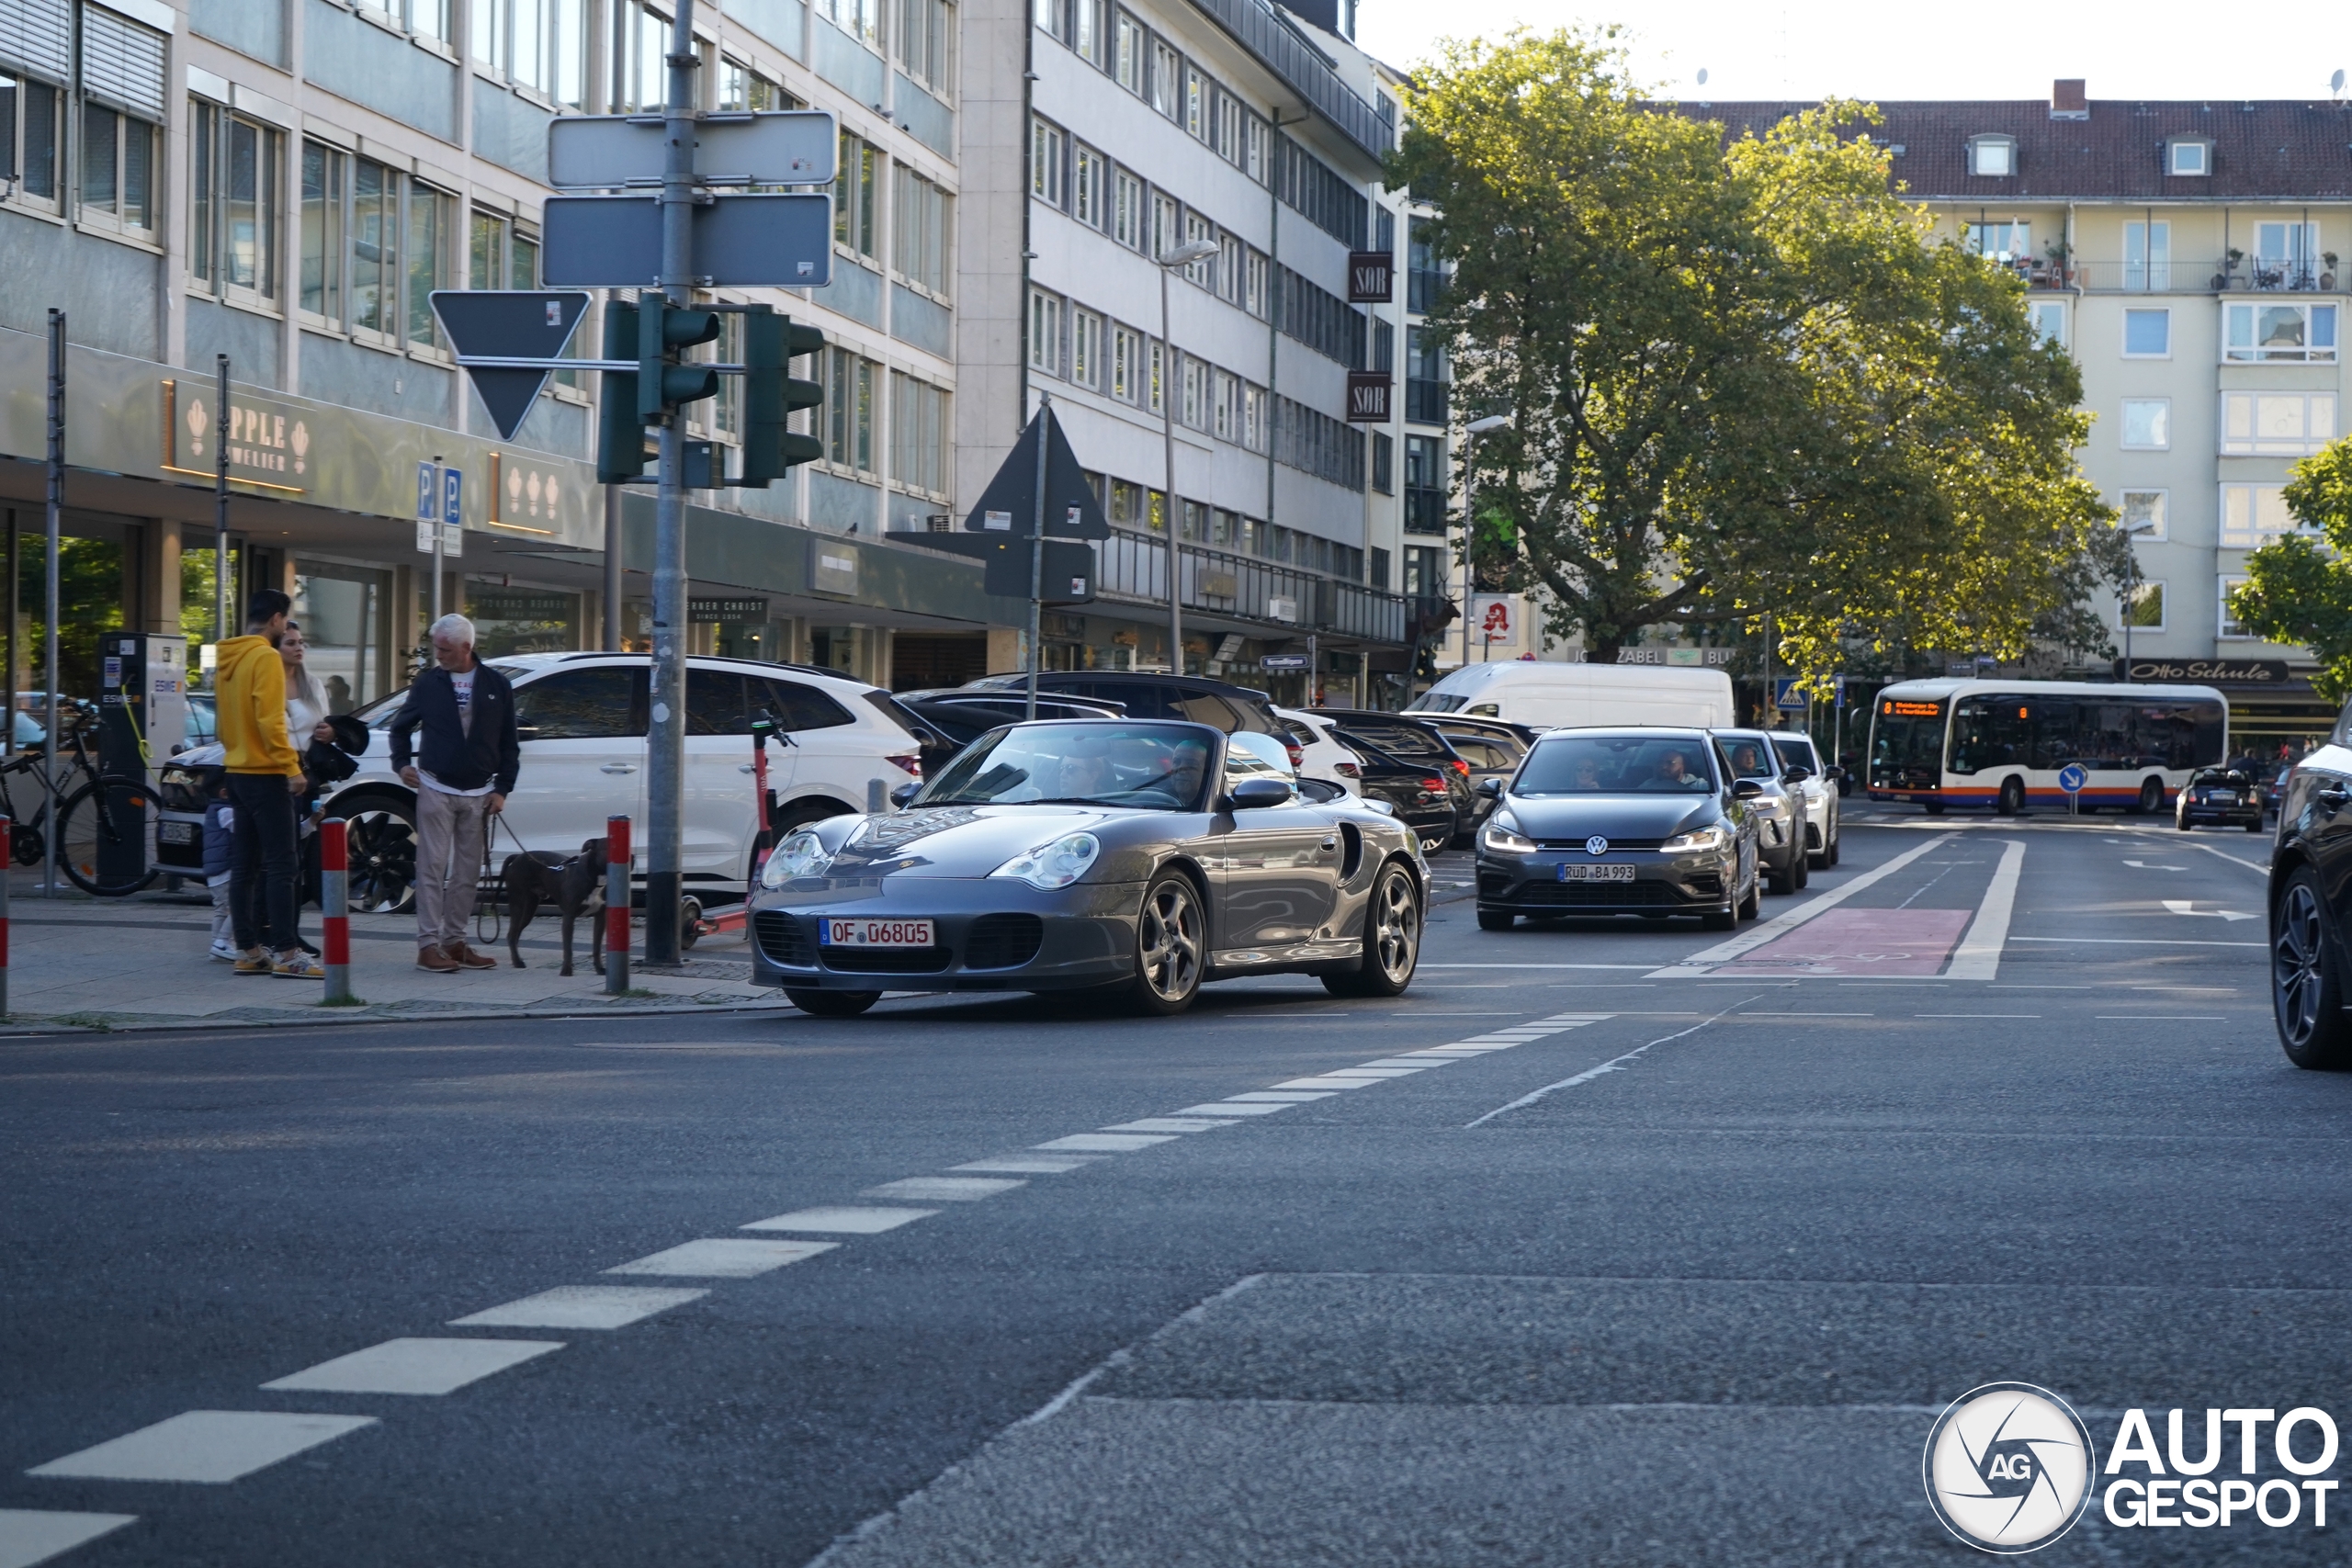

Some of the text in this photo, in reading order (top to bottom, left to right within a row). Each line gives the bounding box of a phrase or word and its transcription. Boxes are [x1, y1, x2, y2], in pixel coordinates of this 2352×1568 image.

[216, 402, 286, 449] PPLE
[421, 469, 431, 511] P
[447, 476, 458, 516] P
[724, 602, 763, 611] CHRIST
[1616, 650, 1661, 665] ZABEL
[2131, 663, 2185, 680] Otto
[1883, 701, 1892, 715] 8
[1595, 866, 1610, 878] BA
[1612, 866, 1634, 878] 993
[832, 922, 855, 942] OF
[867, 923, 929, 943] 06805
